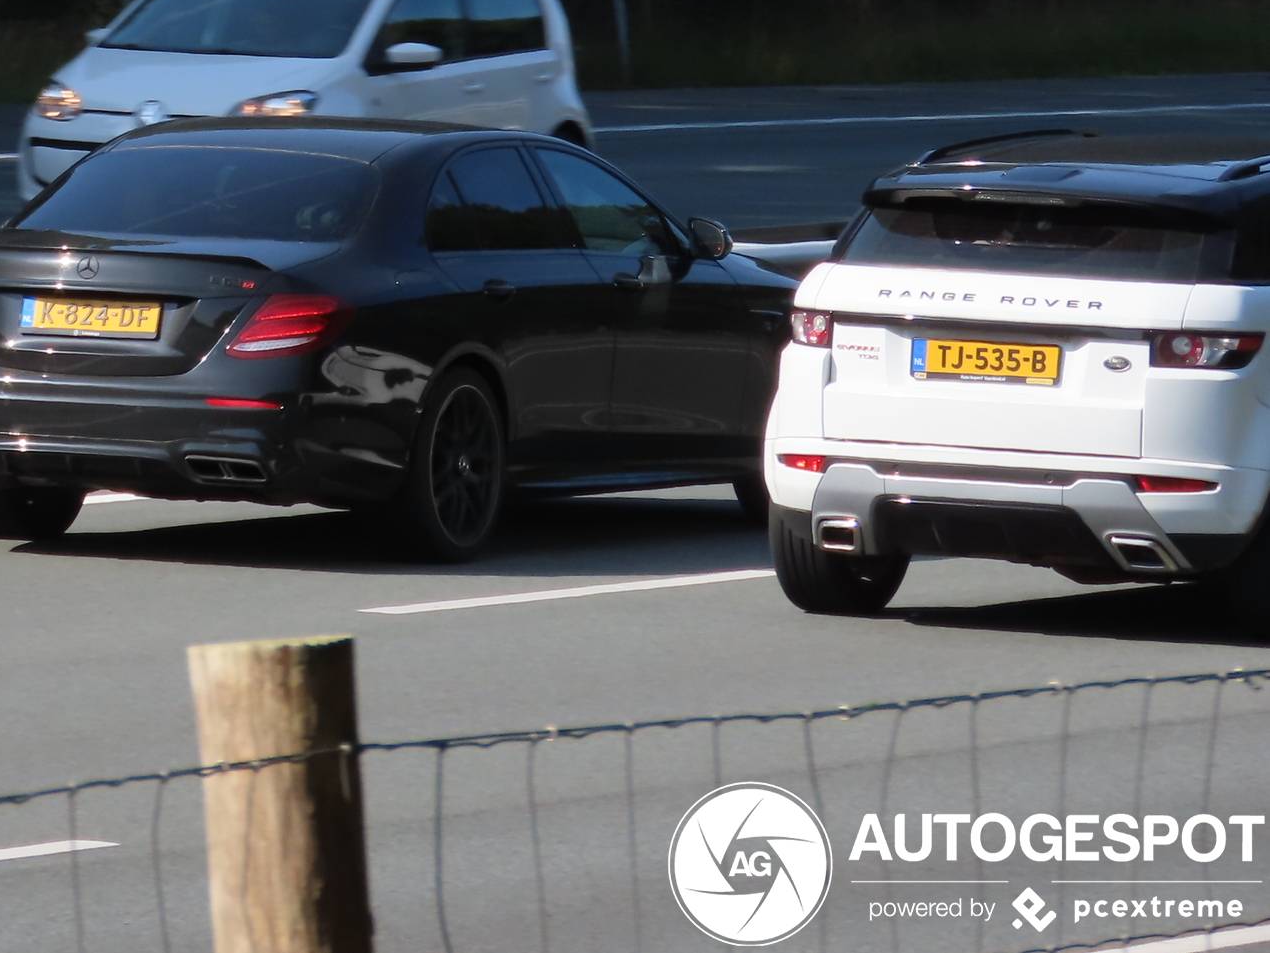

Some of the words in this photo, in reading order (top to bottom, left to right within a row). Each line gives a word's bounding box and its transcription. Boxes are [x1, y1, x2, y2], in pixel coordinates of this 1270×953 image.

[877, 289, 977, 303] RANGE
[999, 295, 1103, 311] ROVER
[22, 315, 33, 323] NL
[40, 300, 151, 328] K-824-DF
[913, 358, 925, 366] NL
[937, 345, 1047, 374] TJ-535-B
